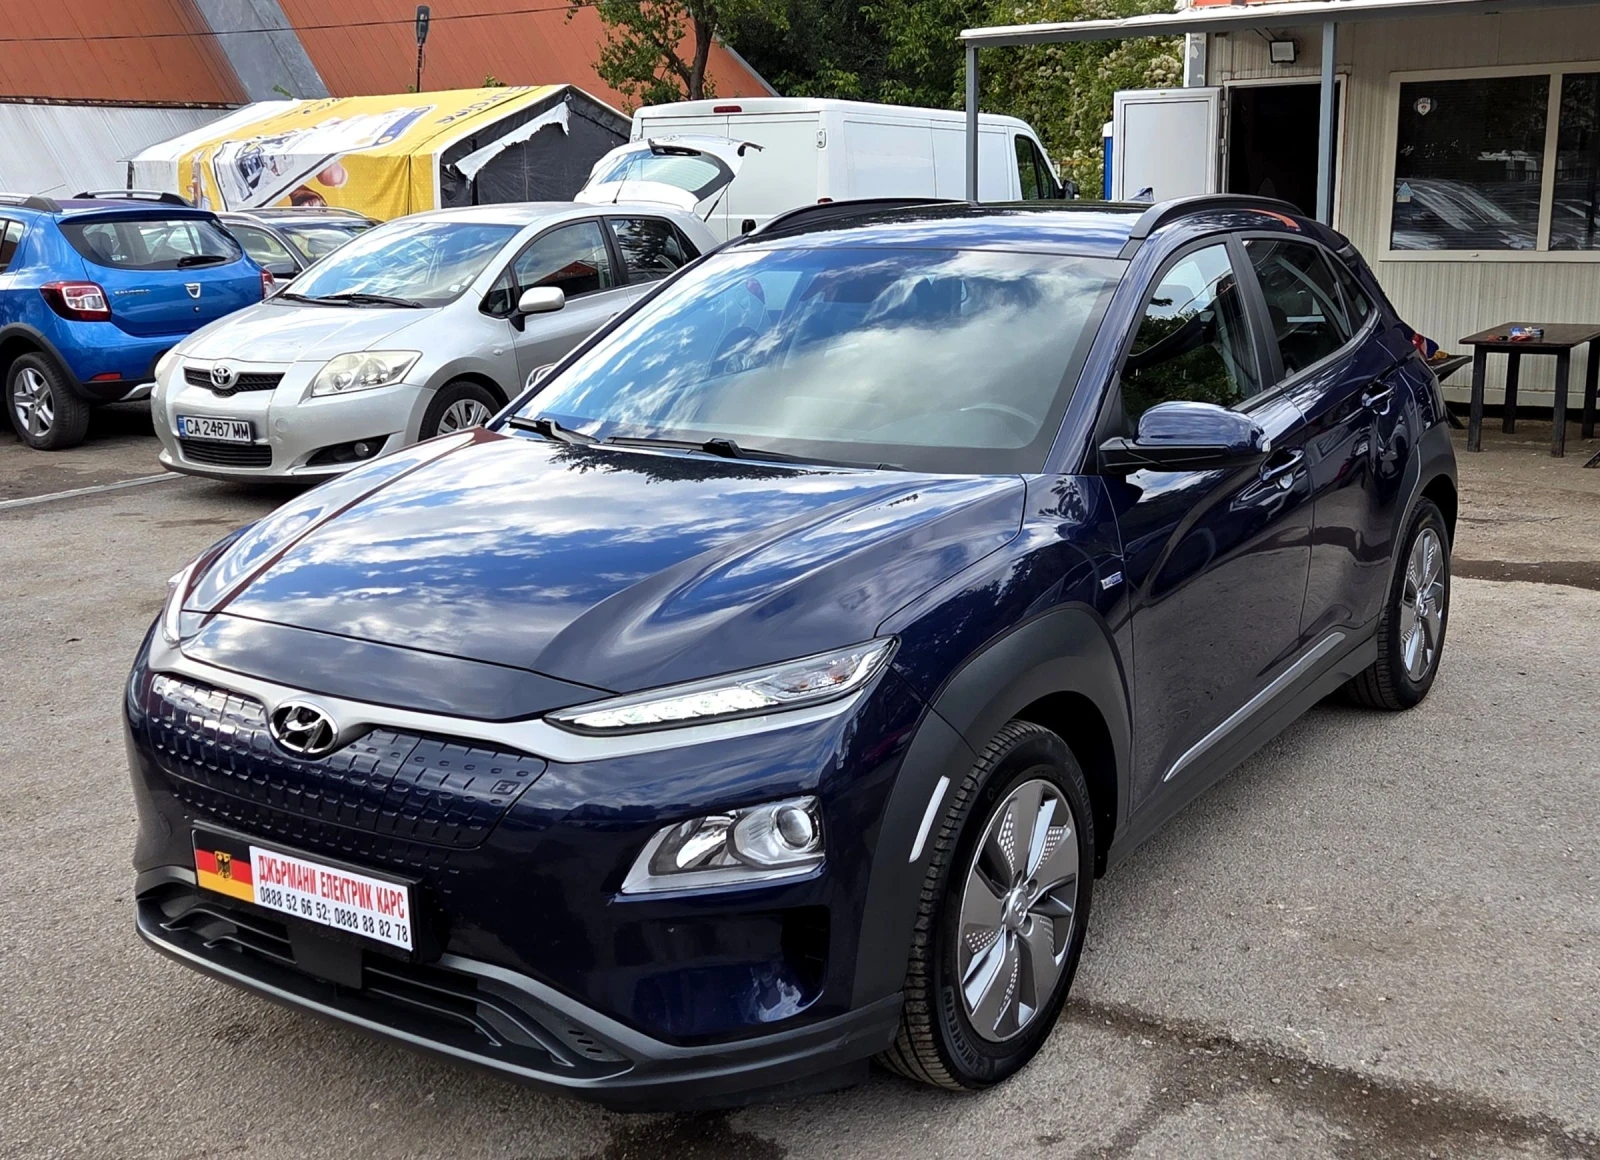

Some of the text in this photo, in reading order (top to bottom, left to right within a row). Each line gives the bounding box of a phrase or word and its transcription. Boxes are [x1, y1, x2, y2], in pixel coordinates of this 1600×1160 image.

[186, 419, 249, 439] CA 2487 MM
[257, 854, 405, 919] ДЖЪРМАНИ ЕЛЕКТРИК КАРС
[260, 886, 283, 908] 0888
[286, 893, 298, 912] 52
[300, 897, 313, 916] 66
[334, 907, 359, 930] 0888
[362, 914, 375, 933] 88
[379, 919, 392, 938] 82
[394, 923, 409, 942] 78
[943, 990, 976, 1067] MICHELIN
